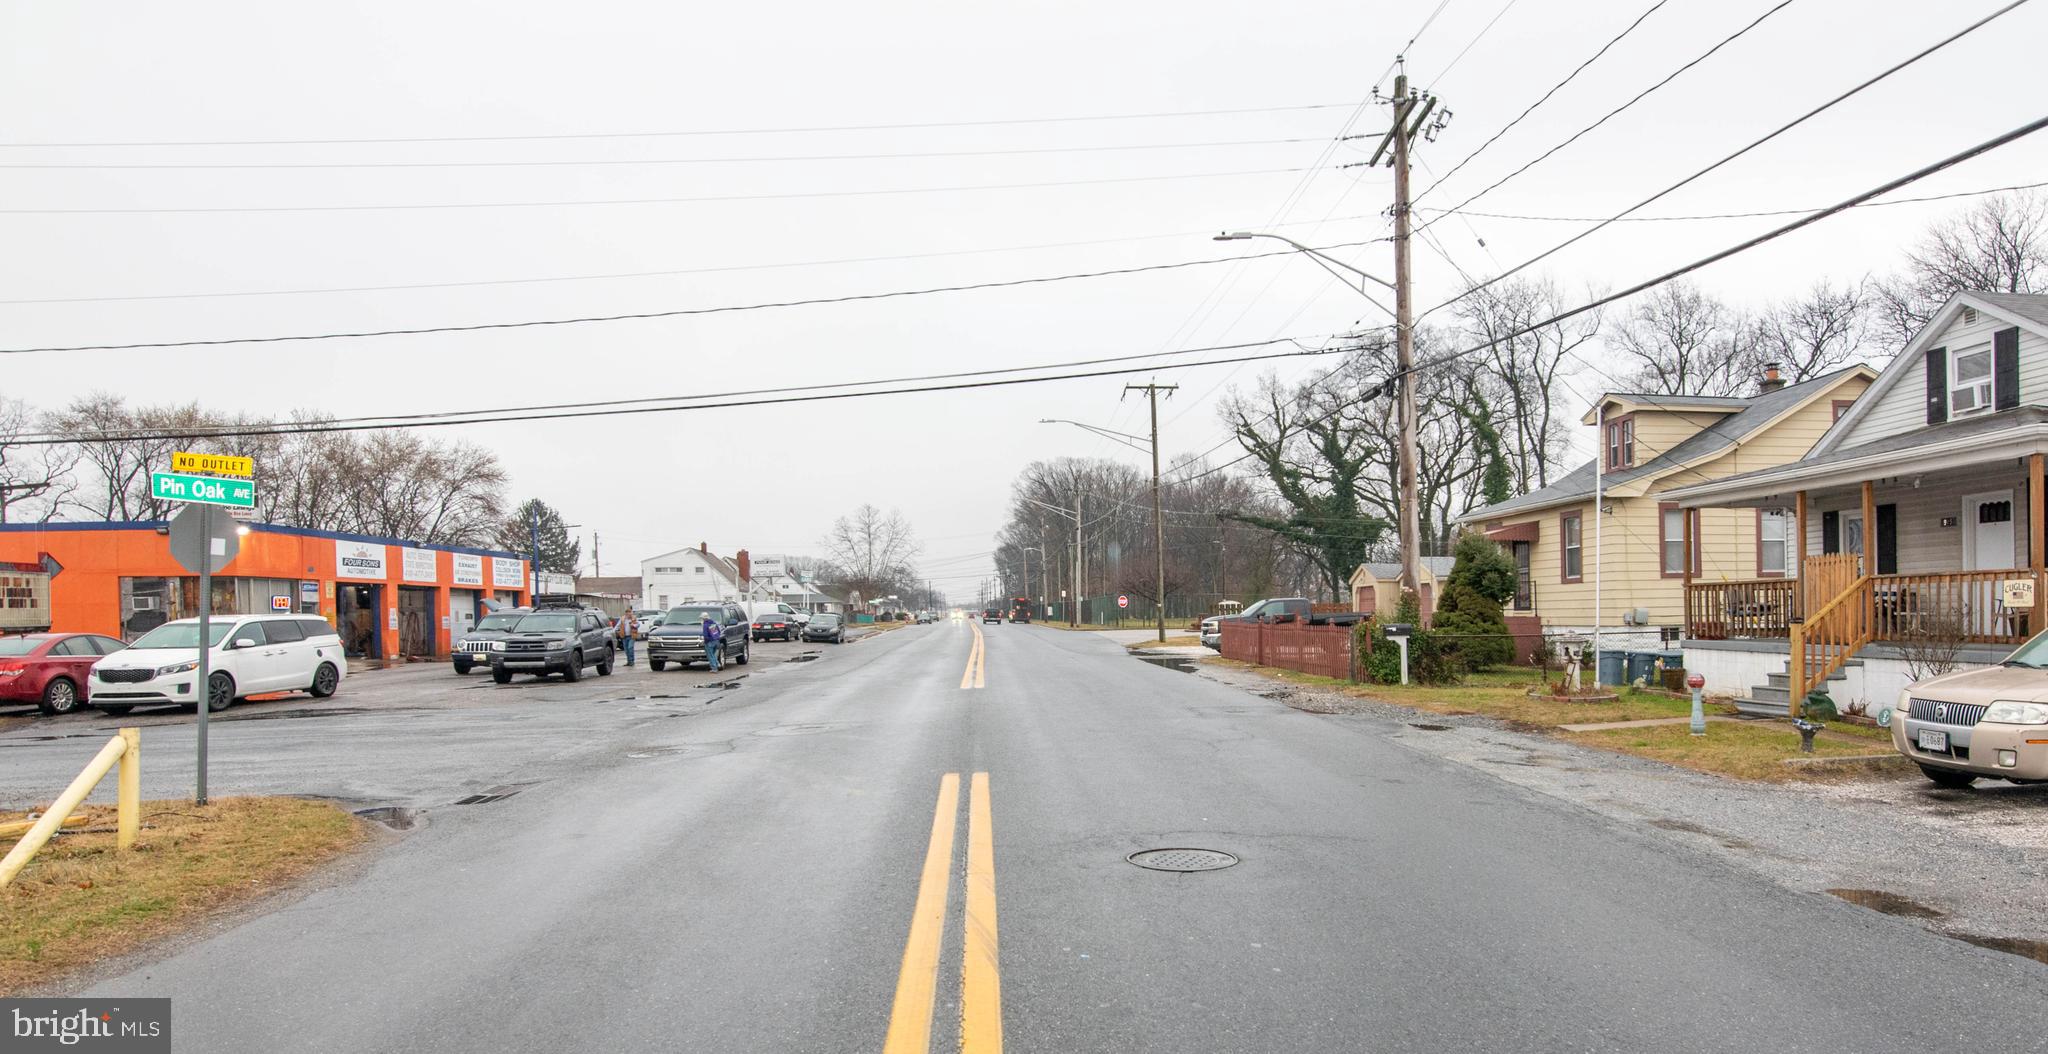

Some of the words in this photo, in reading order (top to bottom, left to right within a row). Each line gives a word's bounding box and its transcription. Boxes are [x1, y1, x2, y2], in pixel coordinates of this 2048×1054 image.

[180, 457, 195, 467] NO
[202, 458, 246, 471] OUTLET
[160, 477, 185, 495] Pin
[192, 480, 225, 499] Oak
[233, 488, 251, 499] AVE
[344, 558, 363, 567] FOUR
[362, 560, 379, 568] SONS
[2005, 583, 2032, 593] CUGLER
